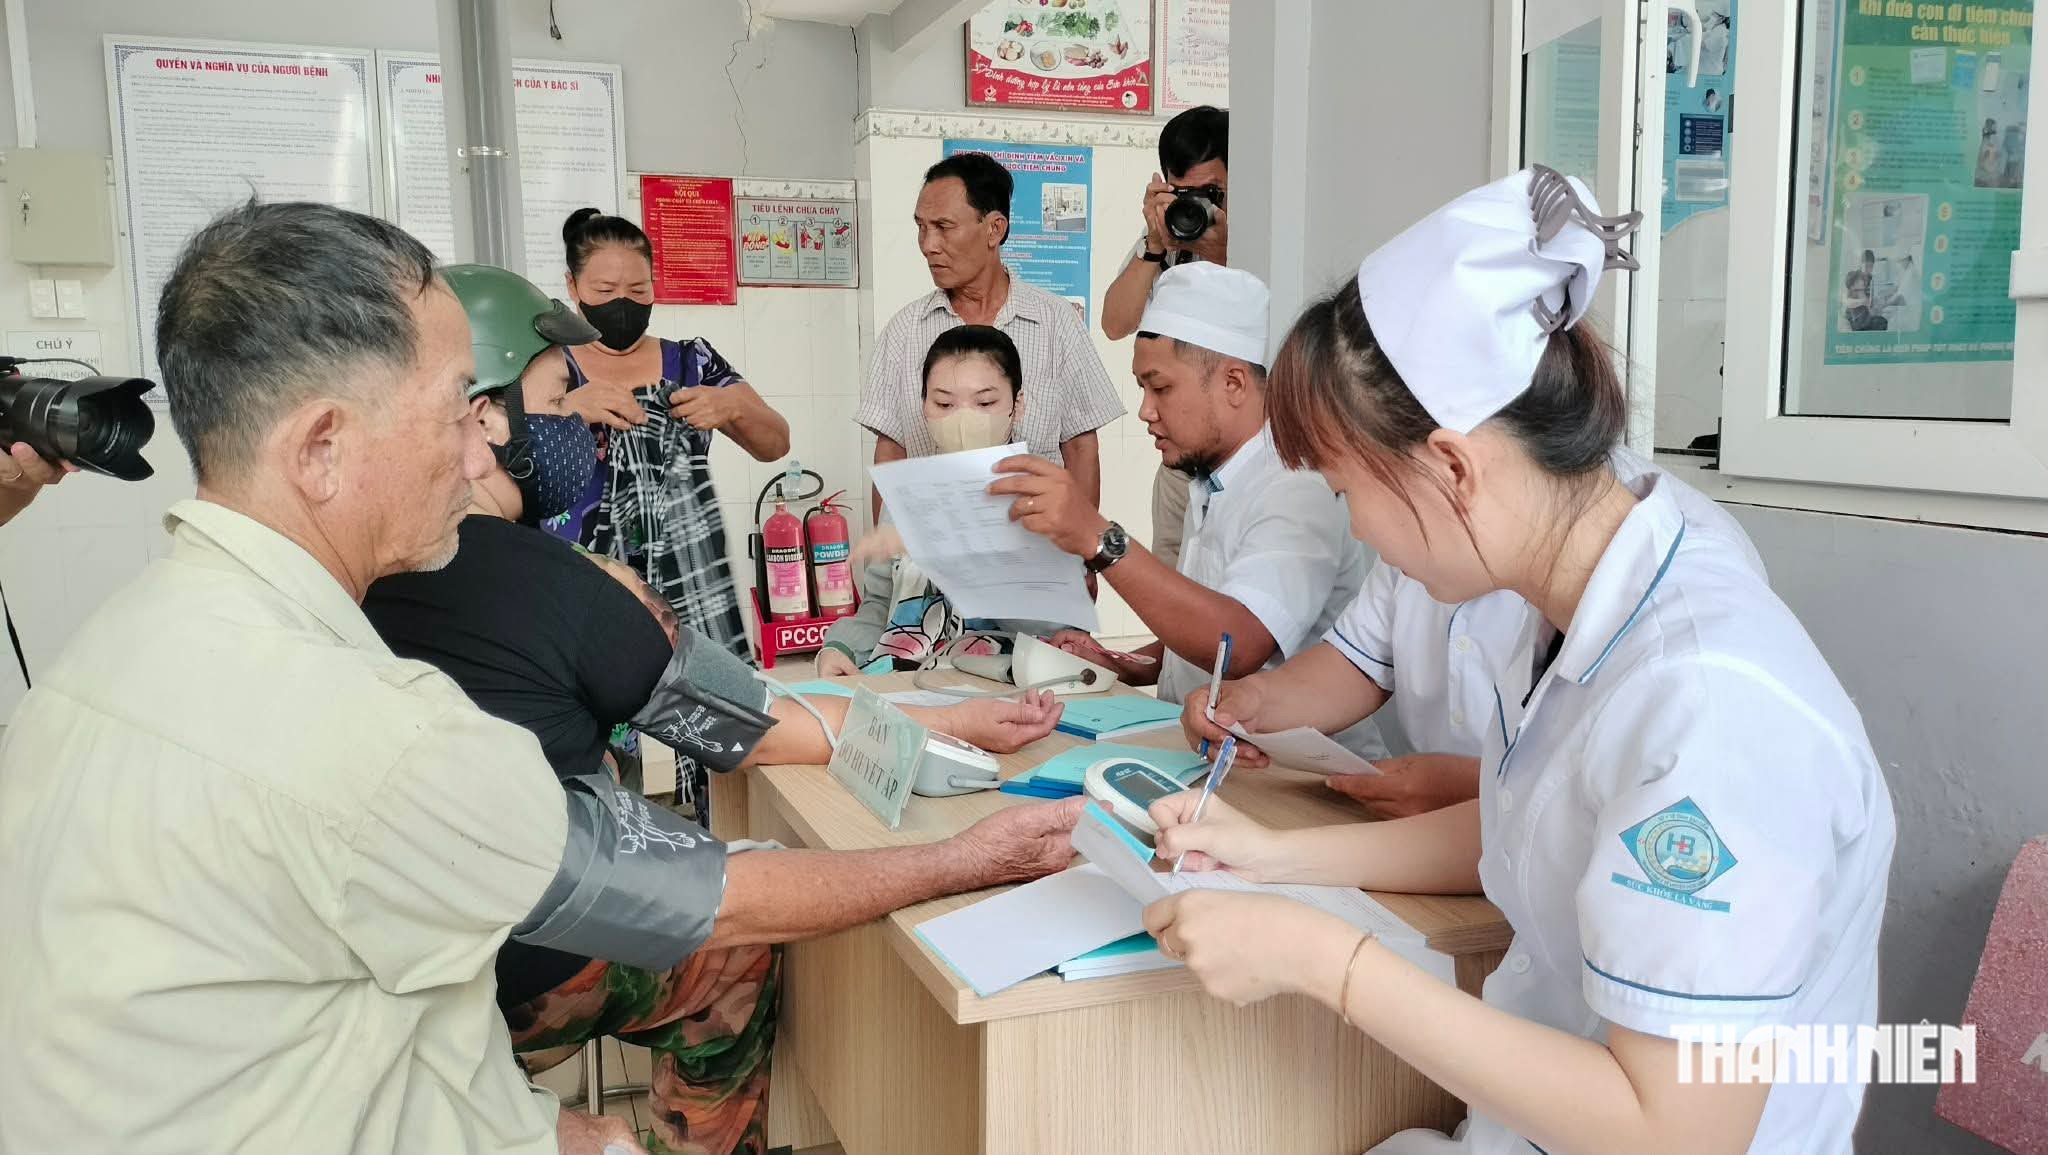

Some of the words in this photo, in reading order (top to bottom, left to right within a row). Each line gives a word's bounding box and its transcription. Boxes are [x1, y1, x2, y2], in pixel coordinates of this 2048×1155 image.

[1917, 4, 1944, 21] con
[1948, 3, 1962, 22] đi
[190, 58, 202, 70] VÀ
[205, 61, 234, 72] NGHĨA
[237, 63, 249, 75] VỤ
[252, 61, 270, 74] CỦA
[273, 64, 301, 76] NGƯỜI
[303, 65, 328, 79] BỆNH
[543, 79, 549, 89] Y
[1026, 151, 1044, 161] TIÊM
[1041, 163, 1066, 172] CHỦNG
[772, 204, 794, 215] LỆNH
[796, 205, 817, 215] CHỮA
[819, 206, 840, 215] CHÁY
[36, 337, 62, 350] CHÚ
[880, 768, 899, 801] ÁP
